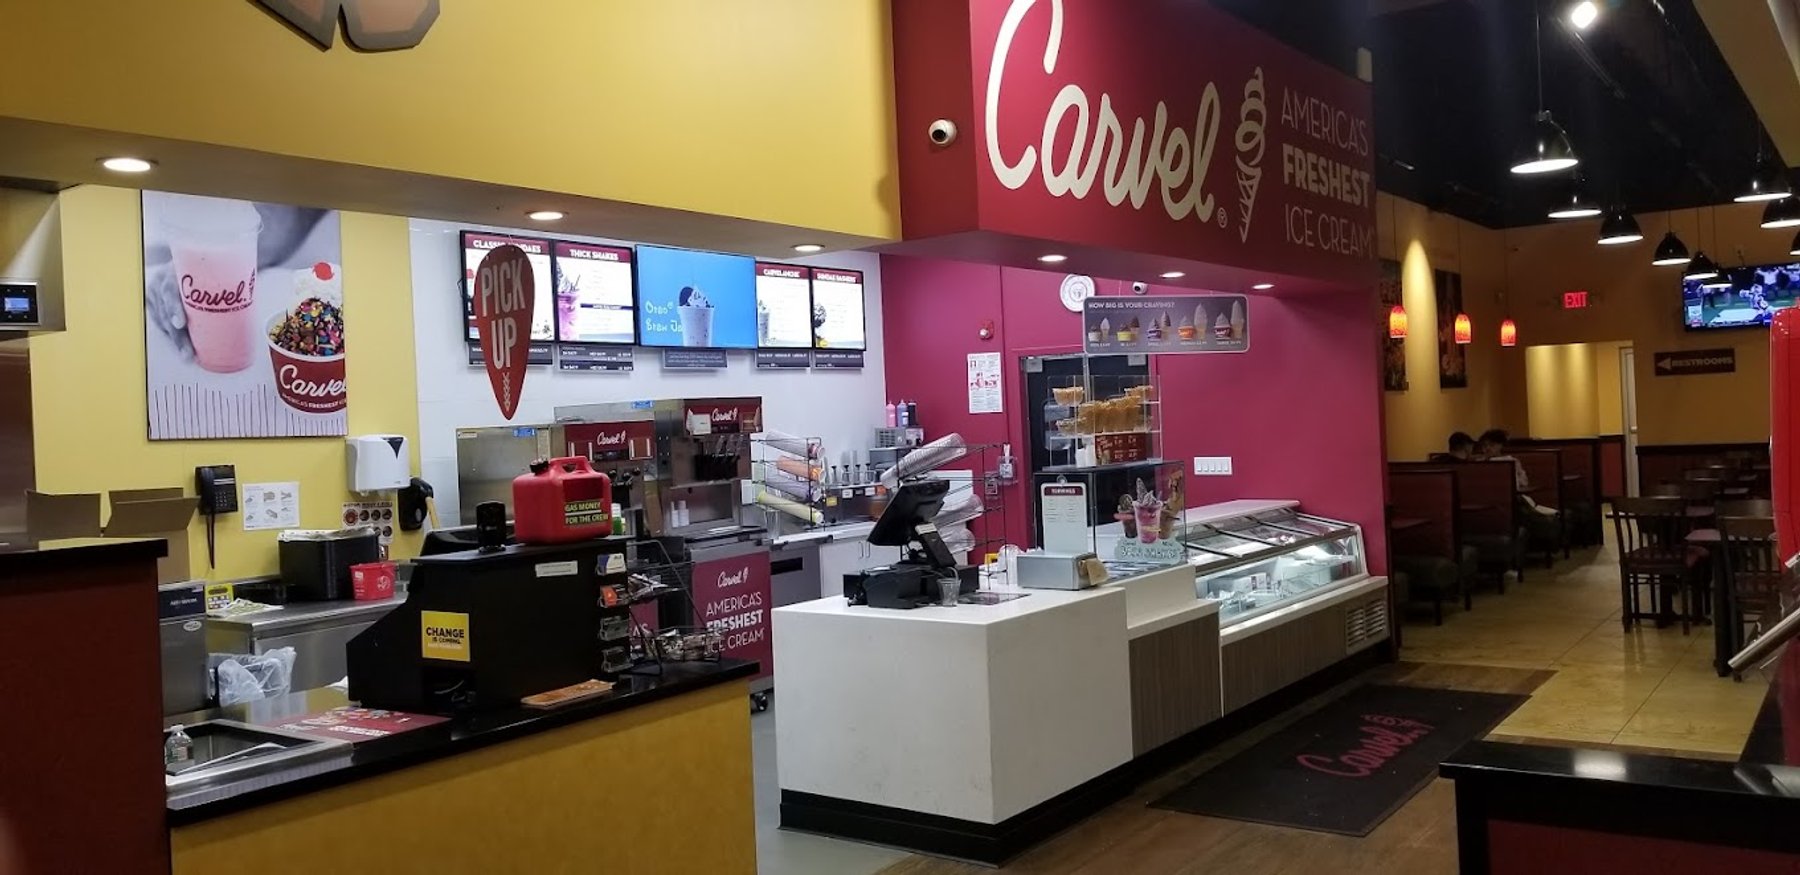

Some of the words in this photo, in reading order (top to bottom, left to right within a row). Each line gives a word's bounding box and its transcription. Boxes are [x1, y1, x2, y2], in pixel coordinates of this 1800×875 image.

[985, 0, 1220, 222] Carvel
[1281, 86, 1369, 156] AMERICA'S
[1282, 143, 1371, 208] FRESHEST
[1285, 203, 1315, 247] ICE
[1318, 213, 1373, 259] CREAM
[181, 274, 245, 307] Carvel
[480, 258, 526, 318] PICK
[1564, 292, 1588, 308] EXIT
[491, 317, 517, 370] UP
[1672, 356, 1734, 367] RESTROOMS
[564, 503, 578, 512] GAS
[579, 501, 600, 511] MONEY
[564, 516, 578, 524] FOR
[578, 515, 591, 523] THE
[591, 513, 609, 521] CREW
[705, 591, 763, 618] AMERICA'S
[426, 626, 465, 638] CHANGE
[706, 609, 764, 637] FRESHEST
[727, 627, 765, 650] CREAM
